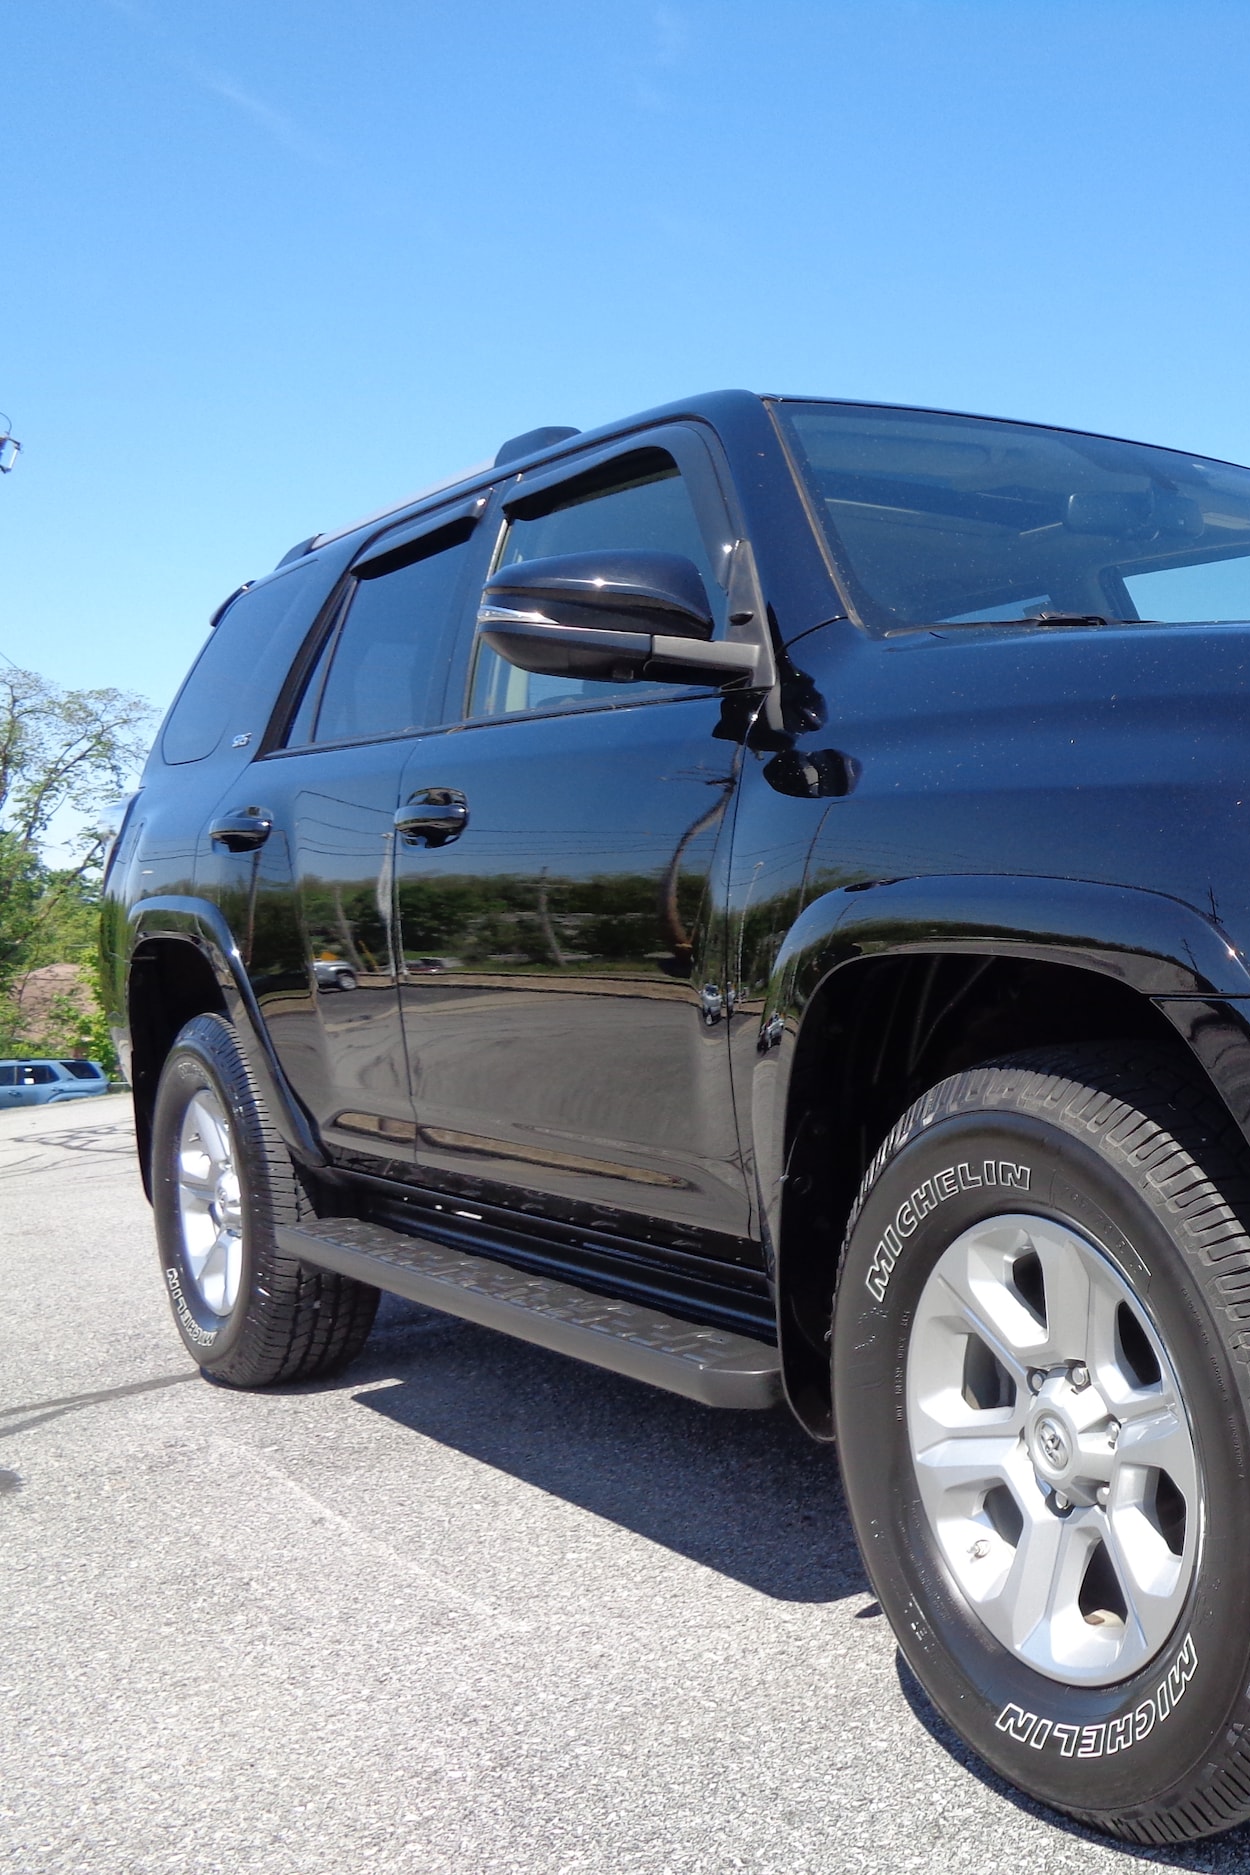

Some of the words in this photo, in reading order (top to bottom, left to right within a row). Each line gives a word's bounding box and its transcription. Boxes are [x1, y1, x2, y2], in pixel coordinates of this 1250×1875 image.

[866, 1161, 1031, 1302] MICHELIN
[167, 1268, 217, 1346] MICHELIN
[996, 1633, 1198, 1758] MICHELIN
